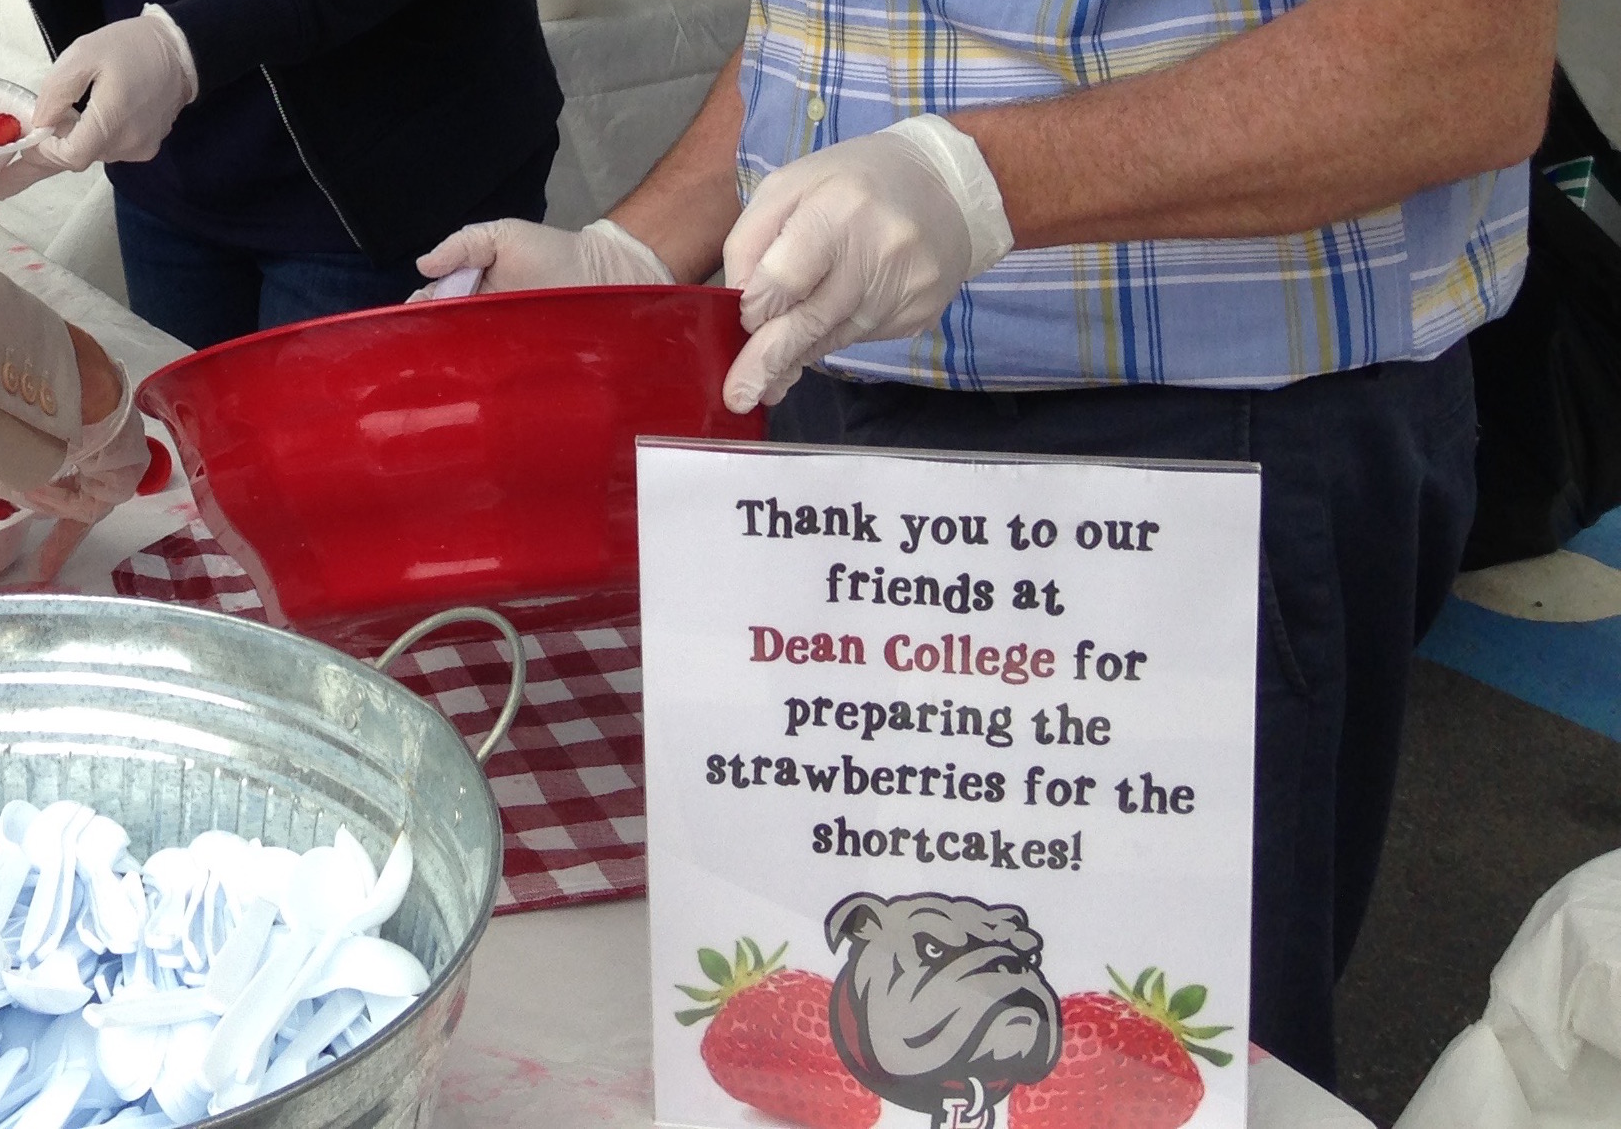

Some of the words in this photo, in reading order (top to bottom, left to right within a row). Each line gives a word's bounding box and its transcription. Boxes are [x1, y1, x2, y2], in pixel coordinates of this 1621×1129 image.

[734, 496, 882, 543] Thank
[898, 514, 989, 555] you
[1006, 514, 1058, 551] to
[1075, 518, 1160, 552] our
[825, 562, 995, 616] friends
[1012, 579, 1065, 618] at
[748, 626, 867, 667] Dean
[883, 633, 1056, 685] College
[1072, 639, 1148, 682] for
[783, 695, 1014, 749] preparing
[1030, 702, 1112, 747] the
[705, 753, 1007, 805] strawberries
[1023, 765, 1097, 808] for
[1114, 771, 1196, 816] the
[811, 815, 1084, 872] shortcakes!
